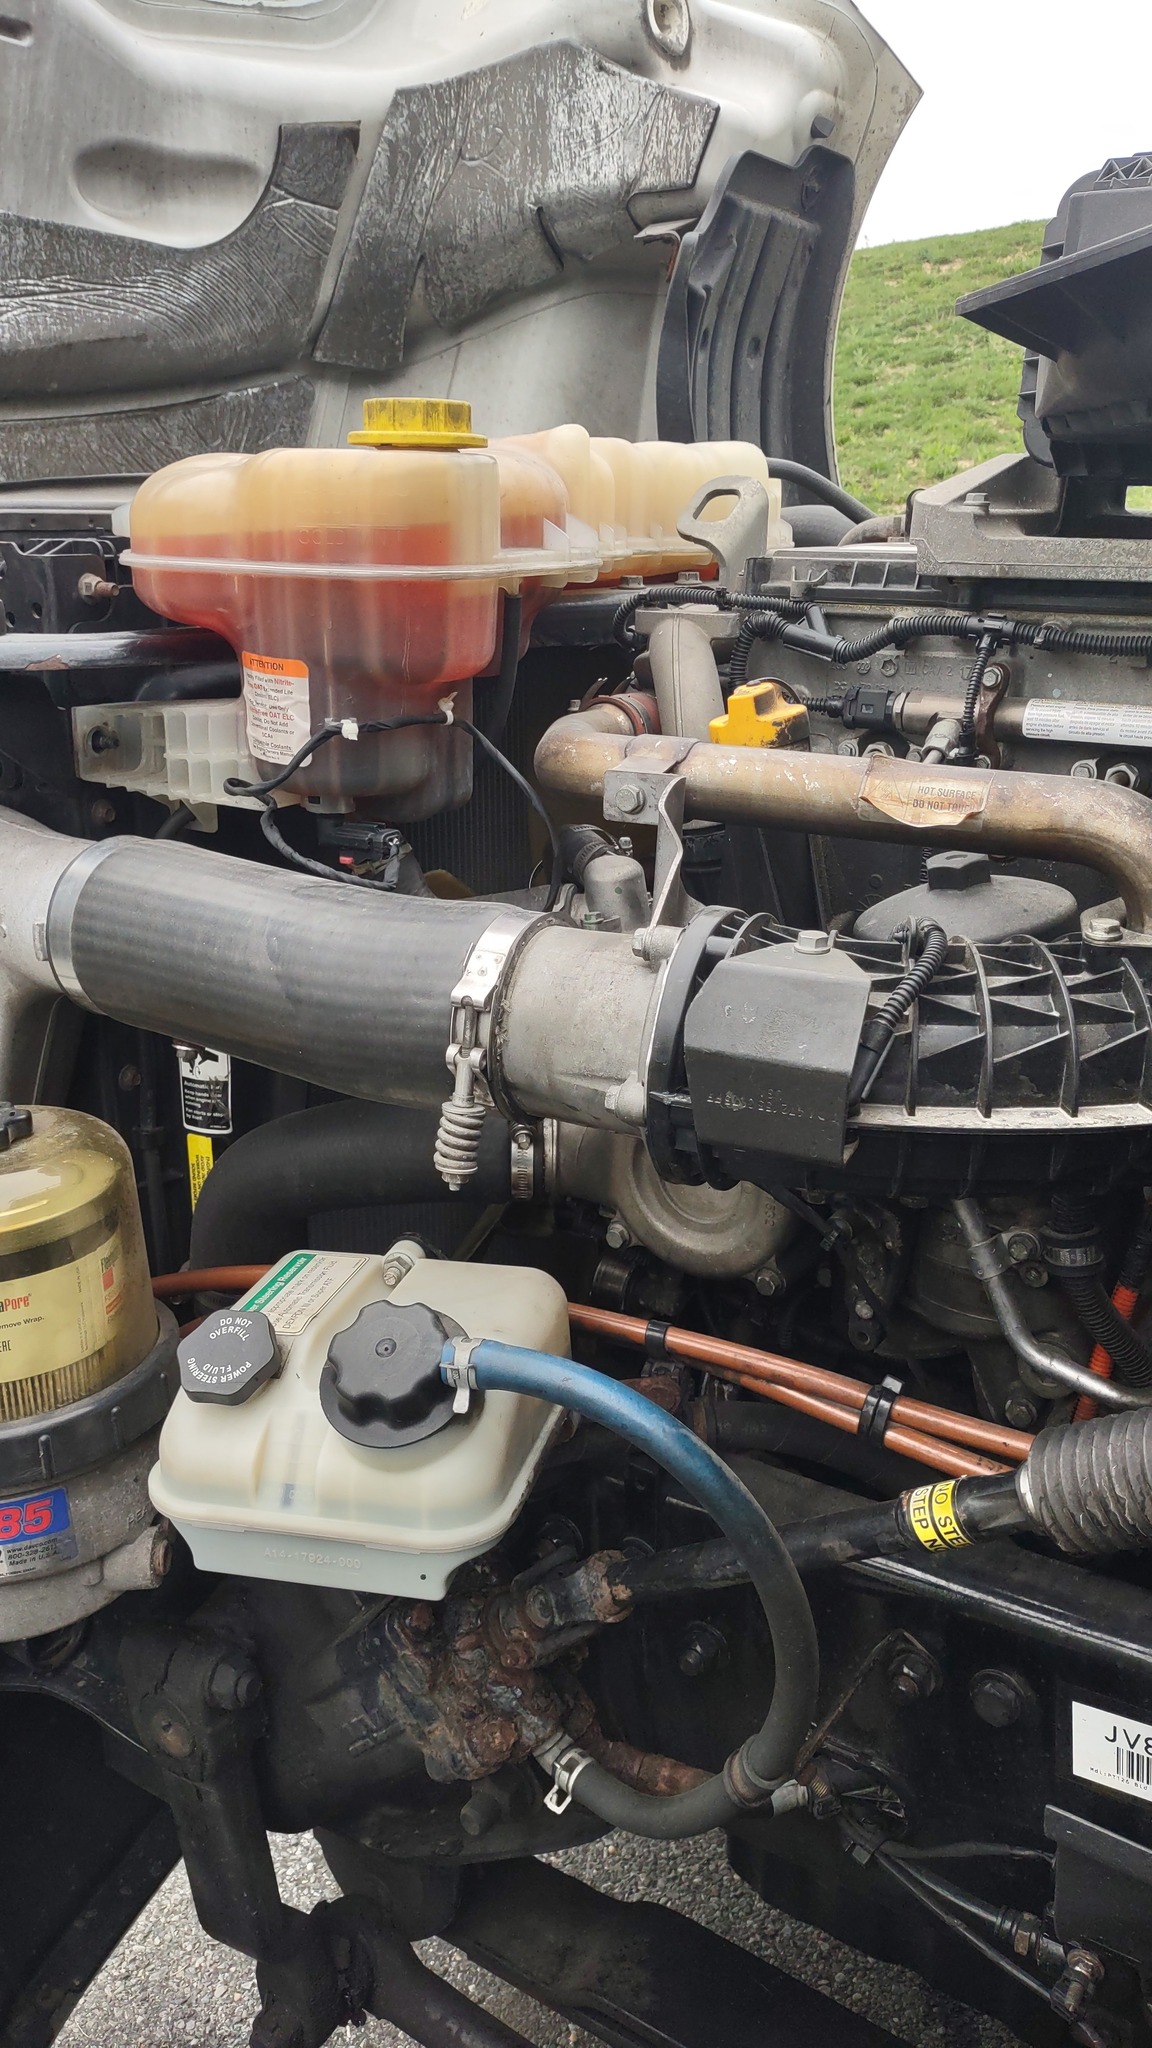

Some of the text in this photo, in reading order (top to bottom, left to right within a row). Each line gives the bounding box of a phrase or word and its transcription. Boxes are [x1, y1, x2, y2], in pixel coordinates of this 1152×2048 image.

[250, 658, 284, 671] ATTENTION
[269, 711, 281, 719] OAT
[282, 713, 295, 722] ELC
[917, 785, 977, 800] HOT SURFACE
[912, 798, 925, 809] DO
[926, 801, 946, 811] NOT
[253, 1279, 287, 1306] Steering
[278, 1295, 303, 1317] Automatic
[0, 1315, 45, 1330] move Wrap.
[220, 1317, 253, 1328] DO NOT
[209, 1325, 250, 1342] OVERFILL
[187, 1357, 252, 1384] POWER STEERING
[202, 1363, 232, 1375] FLUID
[912, 1487, 930, 1530] STEP
[934, 1482, 970, 1550] NO STE
[6, 1537, 58, 1554] www.davco.com
[7, 1544, 58, 1561] 800-328-2611
[8, 1557, 28, 1567] Made
[263, 1547, 362, 1570] A14-17924-000
